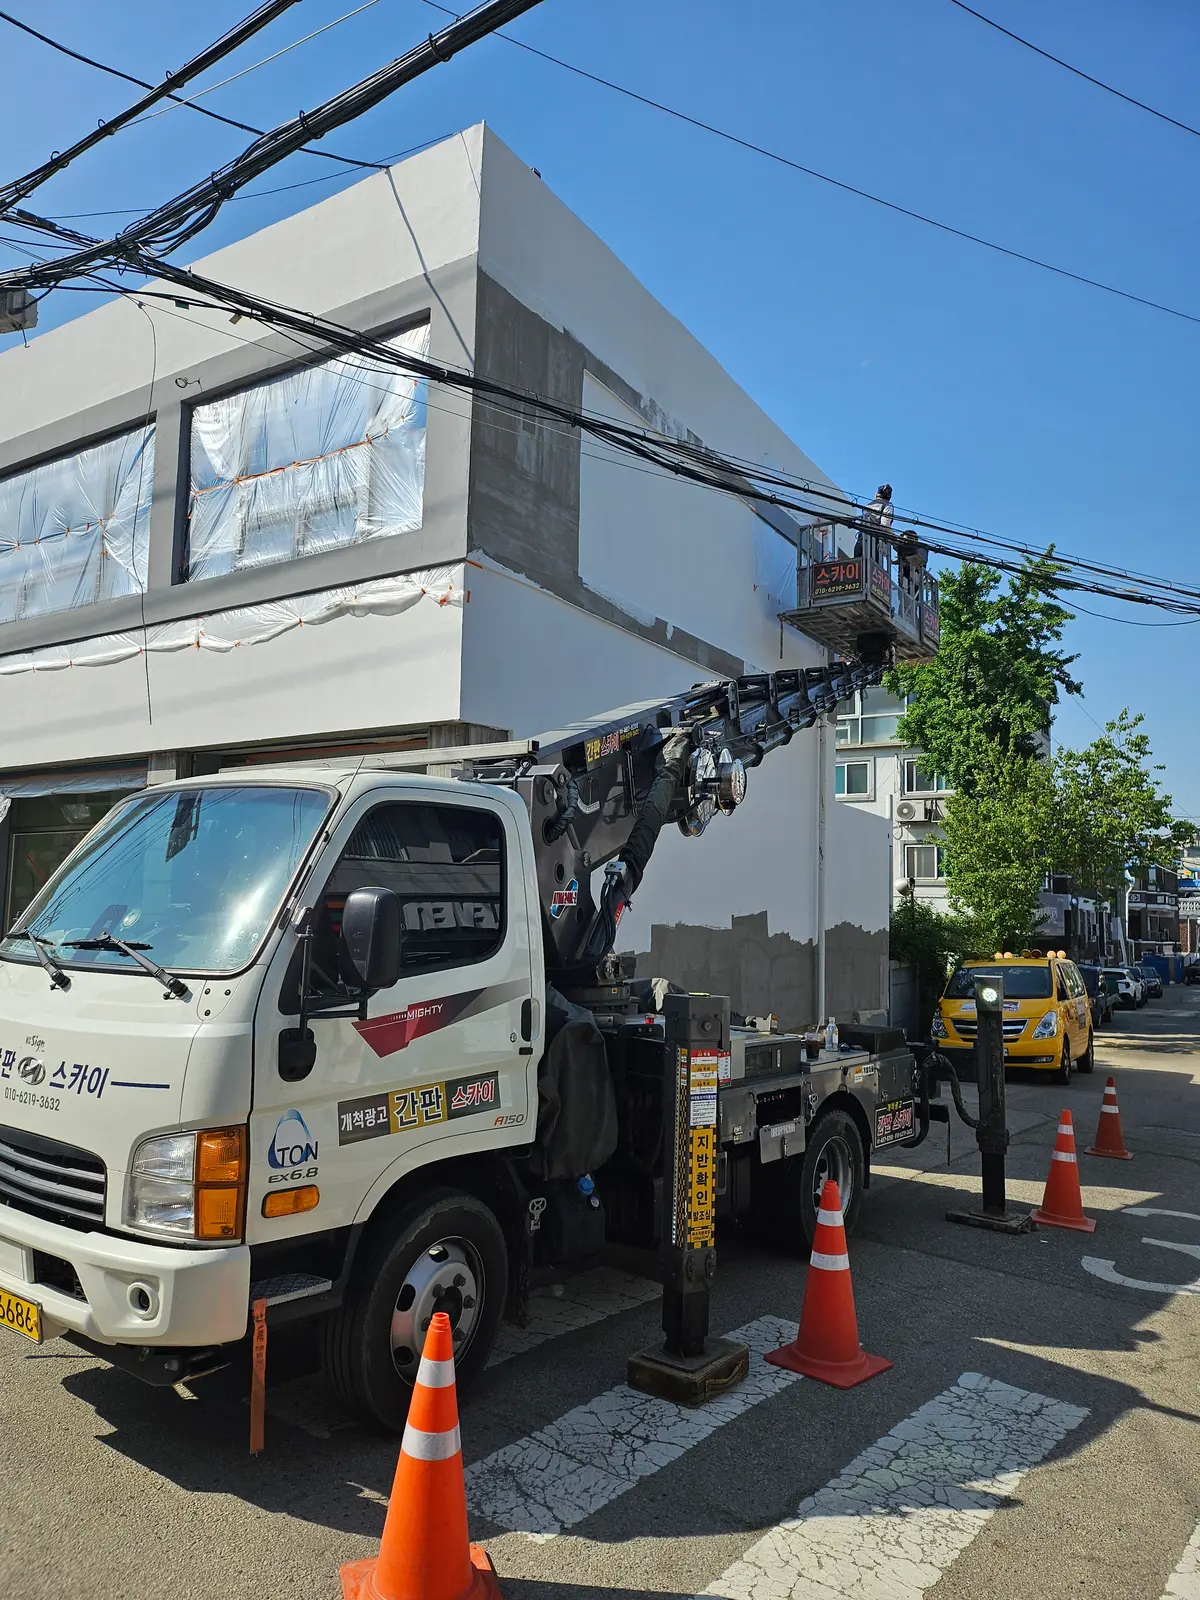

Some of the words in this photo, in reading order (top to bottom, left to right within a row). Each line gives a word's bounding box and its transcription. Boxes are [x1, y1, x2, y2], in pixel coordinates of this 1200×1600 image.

[816, 563, 859, 585] 스카이
[407, 1003, 444, 1020] MIGHTY
[0, 1048, 16, 1079] 판
[50, 1061, 109, 1098] 스카이
[5, 1087, 60, 1112] 010-6219-3632
[340, 1106, 388, 1132] 개척광고
[394, 1086, 443, 1128] 간판
[451, 1080, 495, 1109] 스카이
[494, 1113, 524, 1126] A150
[268, 1167, 318, 1184] EX6.8
